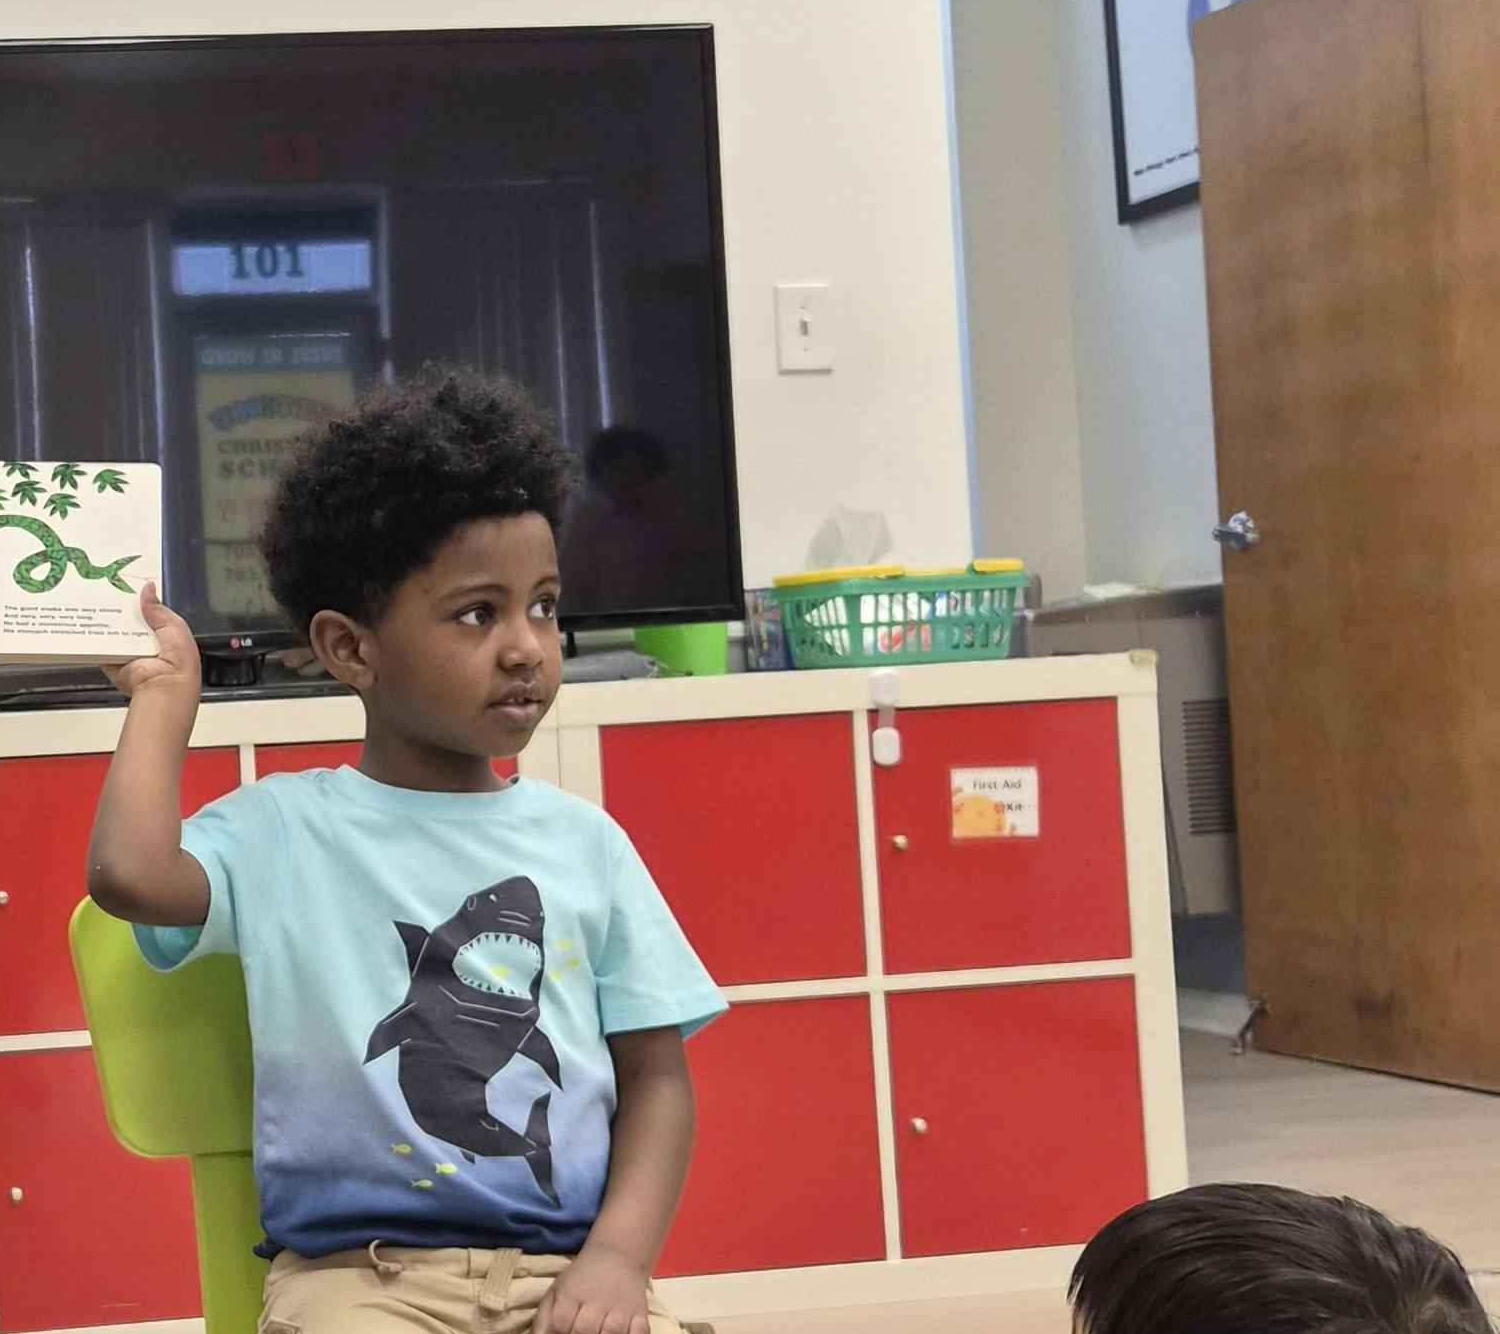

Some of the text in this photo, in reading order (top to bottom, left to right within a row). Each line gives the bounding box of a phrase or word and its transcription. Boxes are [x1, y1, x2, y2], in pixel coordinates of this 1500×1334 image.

[230, 240, 304, 279] 101
[240, 637, 252, 647] LG
[972, 778, 1022, 790] First Aid
[1006, 802, 1024, 812] Kit
